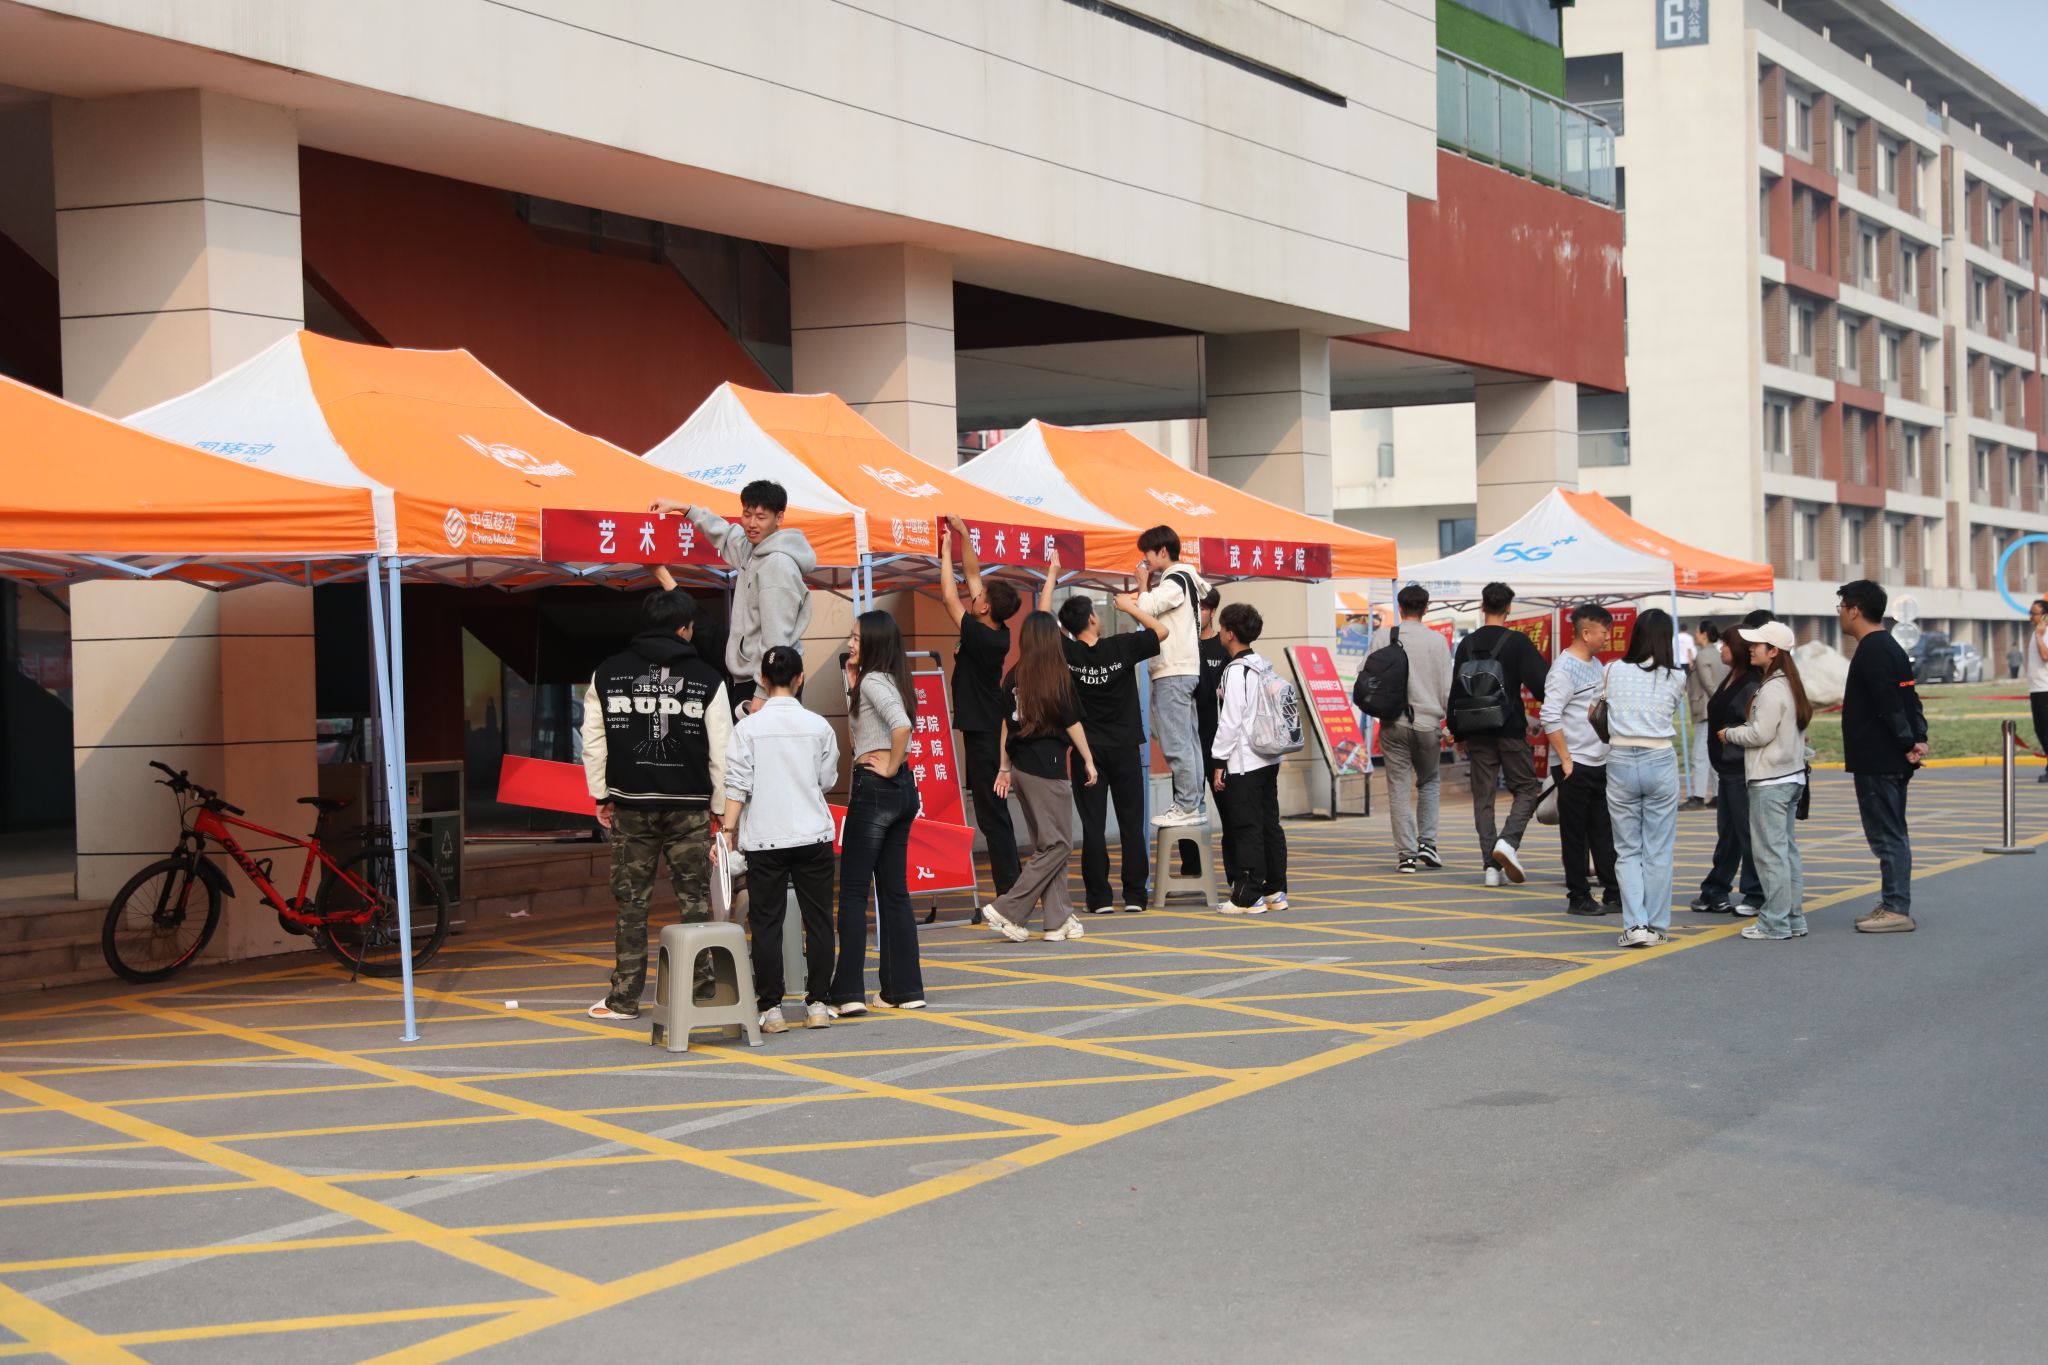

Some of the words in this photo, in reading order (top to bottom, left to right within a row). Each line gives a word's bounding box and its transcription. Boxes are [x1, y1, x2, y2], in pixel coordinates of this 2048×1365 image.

[1663, 0, 1684, 41] 6
[470, 511, 517, 531] 中国移动
[598, 519, 722, 558] 艺术学
[1229, 544, 1306, 571] 武术学院
[1088, 667, 1099, 676] de
[1100, 665, 1108, 675] la
[1109, 661, 1123, 672] vie
[633, 684, 675, 693] JESUS
[1079, 674, 1109, 685] ADLV
